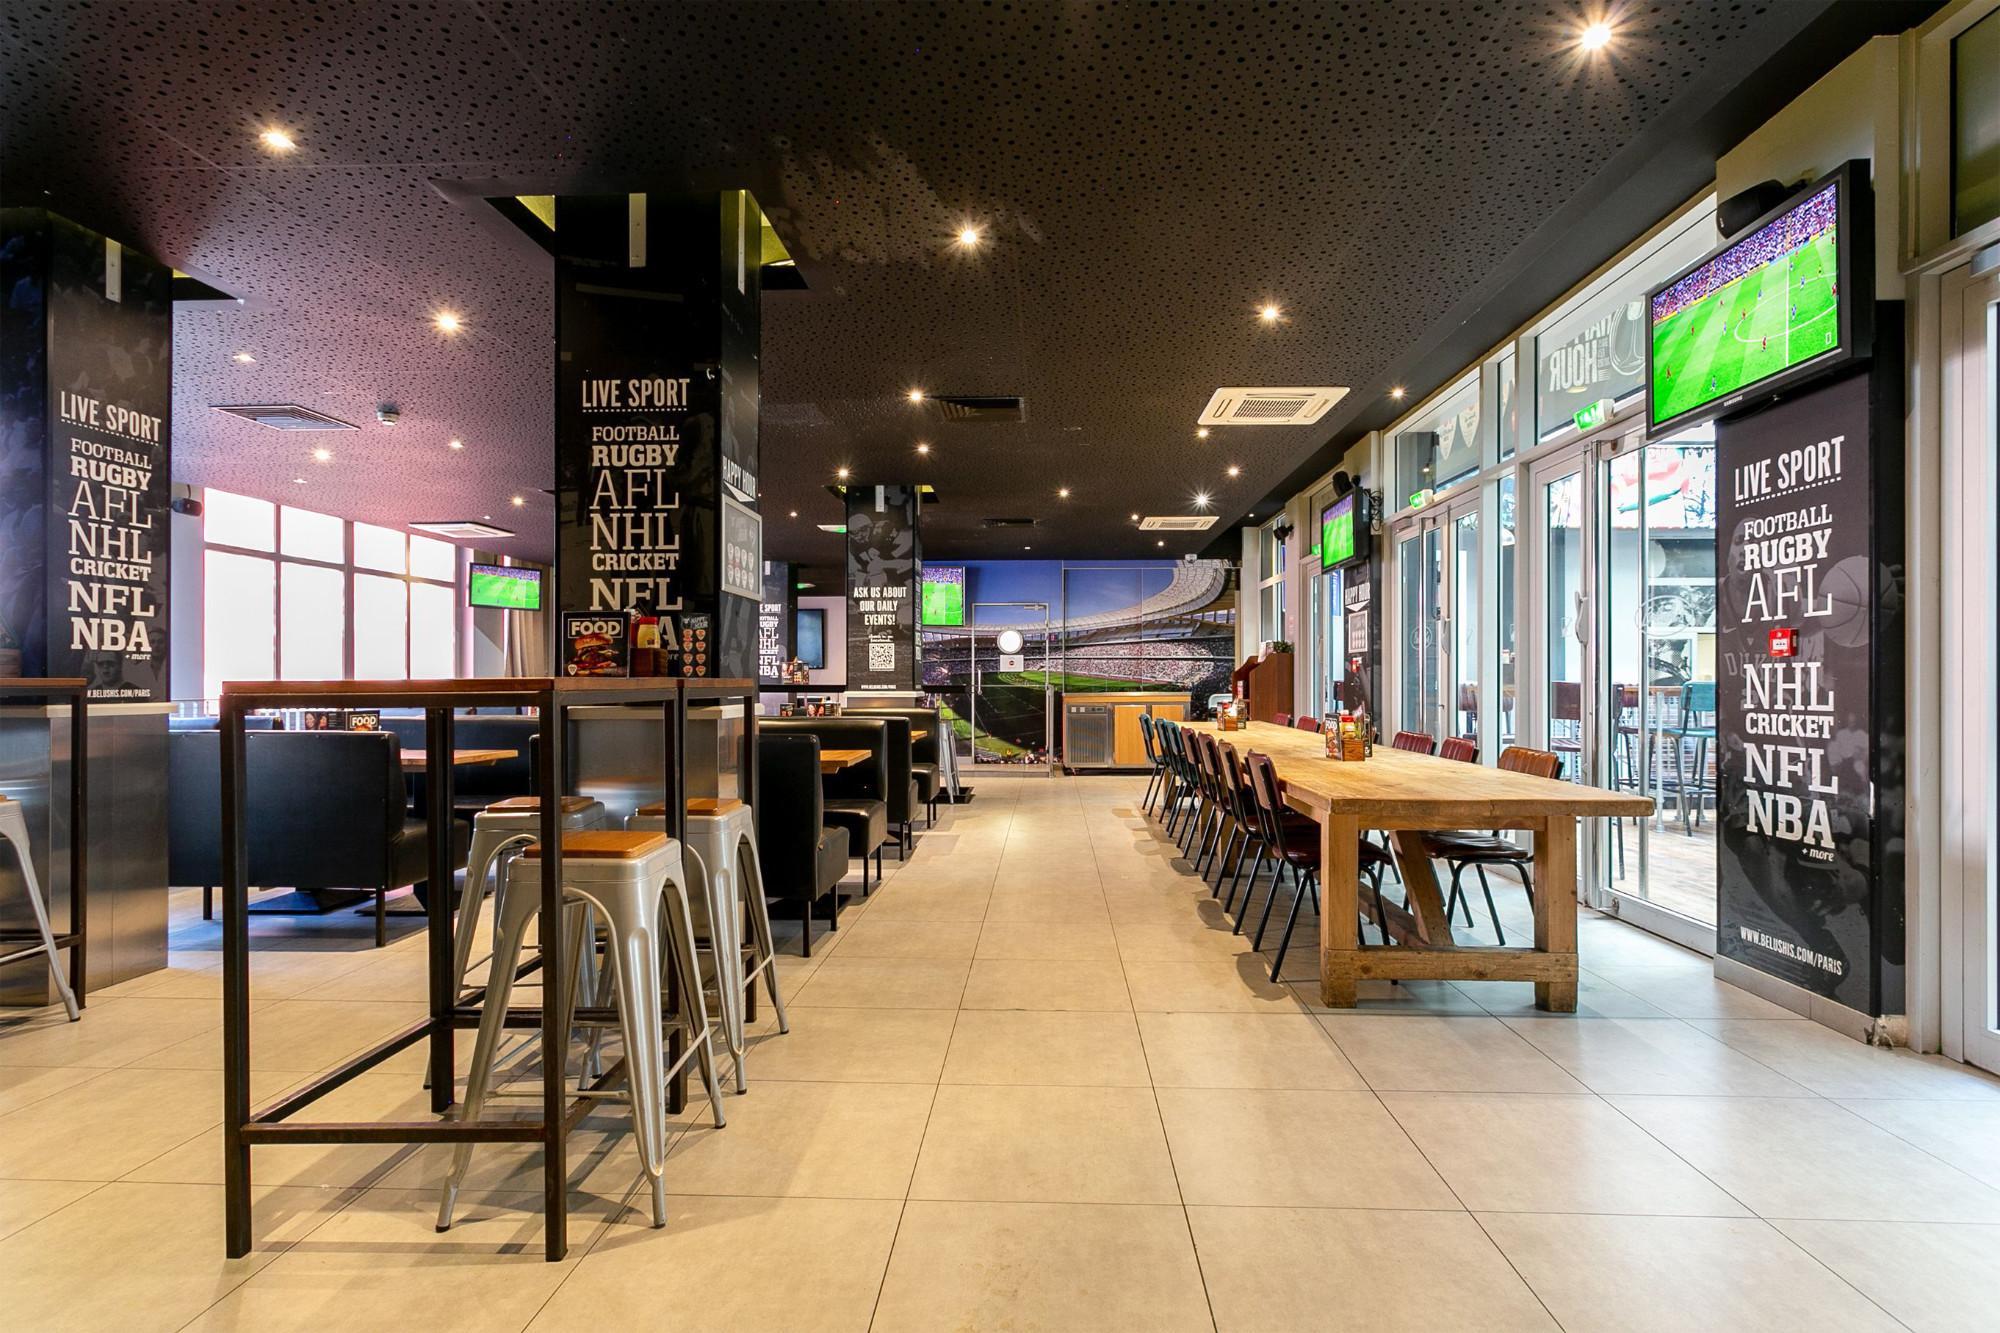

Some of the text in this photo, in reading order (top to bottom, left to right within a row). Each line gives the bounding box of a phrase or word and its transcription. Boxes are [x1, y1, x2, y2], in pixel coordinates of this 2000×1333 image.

[582, 378, 690, 408] LIVE SPORT
[60, 391, 161, 442] LIVE SPORT
[592, 426, 679, 441] FOOTBALL
[71, 438, 152, 469] FOOTBALL
[592, 444, 679, 467] RUGBY
[1735, 435, 1845, 502] LIVE SPORT
[71, 455, 151, 491] RUGBY
[589, 469, 679, 510] AFL
[68, 481, 152, 528] AFL
[1743, 504, 1832, 541] FOOTBALL
[69, 520, 152, 564] NHL
[590, 513, 679, 551] NHL
[1744, 529, 1832, 571] RUGBY
[71, 558, 152, 582] CRICKET
[592, 552, 679, 571] CRICKET
[68, 580, 154, 617] NFL
[590, 577, 683, 611] NFL
[853, 586, 907, 598] ASK US ABOUT
[859, 601, 898, 612] OUR DAILY
[1741, 563, 1832, 624] AFL
[71, 616, 152, 652] NBA
[571, 621, 621, 636] FOOD
[864, 614, 896, 626] EVENTS!
[1743, 662, 1835, 712] NHL
[351, 716, 376, 726] FOOD
[1745, 712, 1834, 739] CRICKET
[1743, 743, 1839, 795] NFL
[1746, 789, 1836, 849] NBA
[1809, 848, 1834, 862] more
[1740, 926, 1842, 976] WWW.BELUSHIS.COM/PARIS
